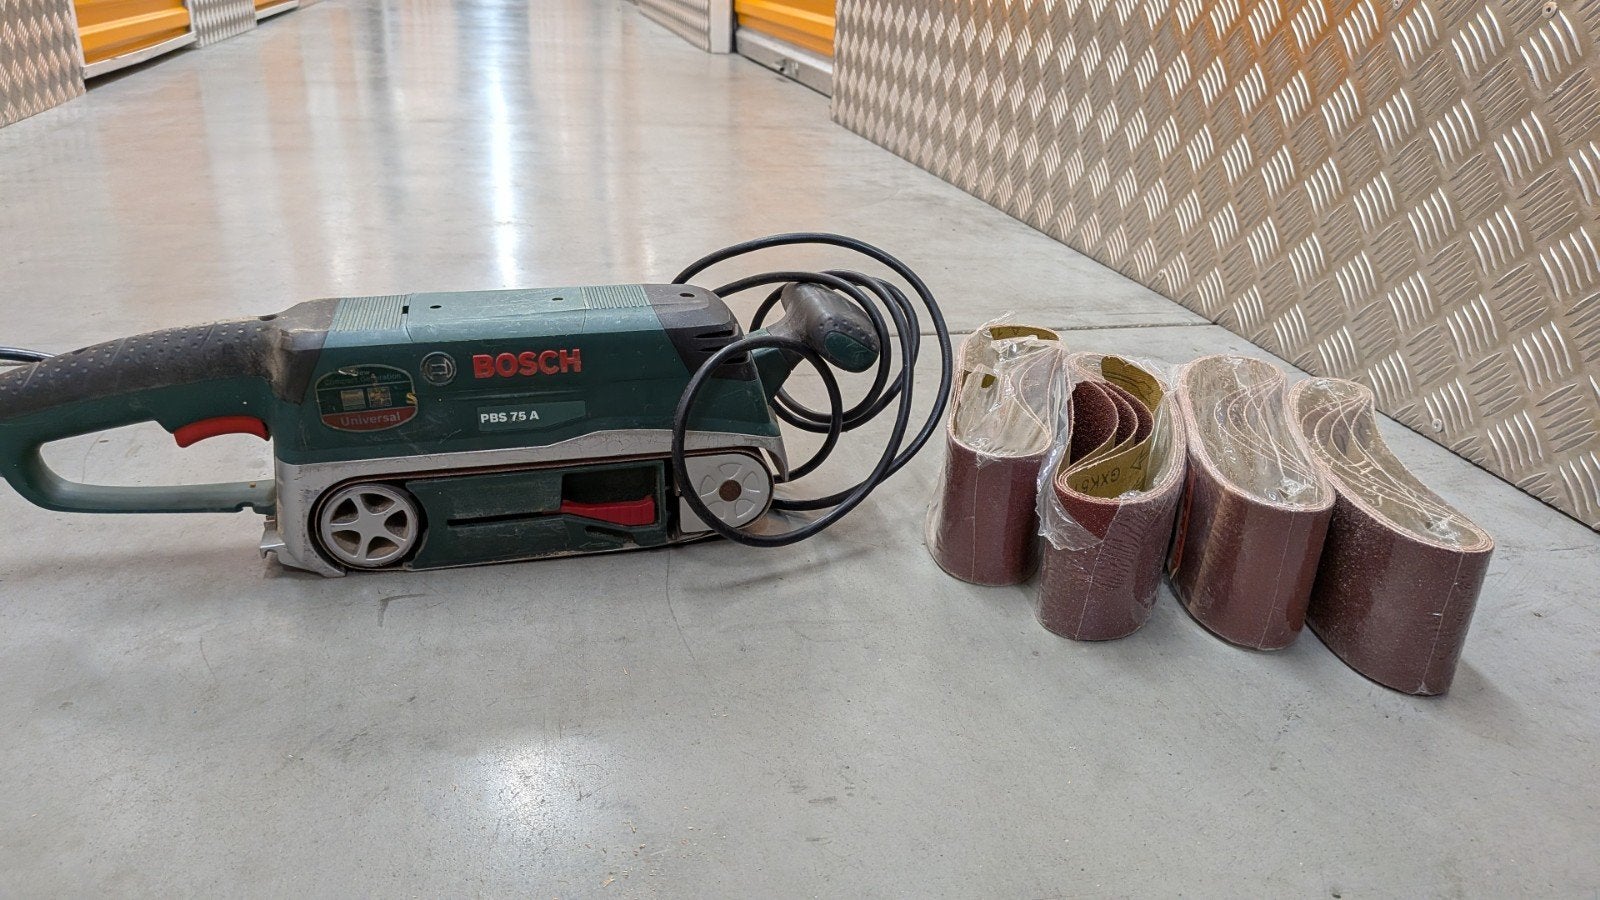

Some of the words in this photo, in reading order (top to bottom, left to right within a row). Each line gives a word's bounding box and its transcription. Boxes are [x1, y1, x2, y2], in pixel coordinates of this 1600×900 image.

[472, 348, 582, 379] BOSCH
[340, 411, 401, 426] Universal
[480, 412, 507, 424] PBS
[509, 411, 527, 422] 75
[529, 410, 540, 421] A
